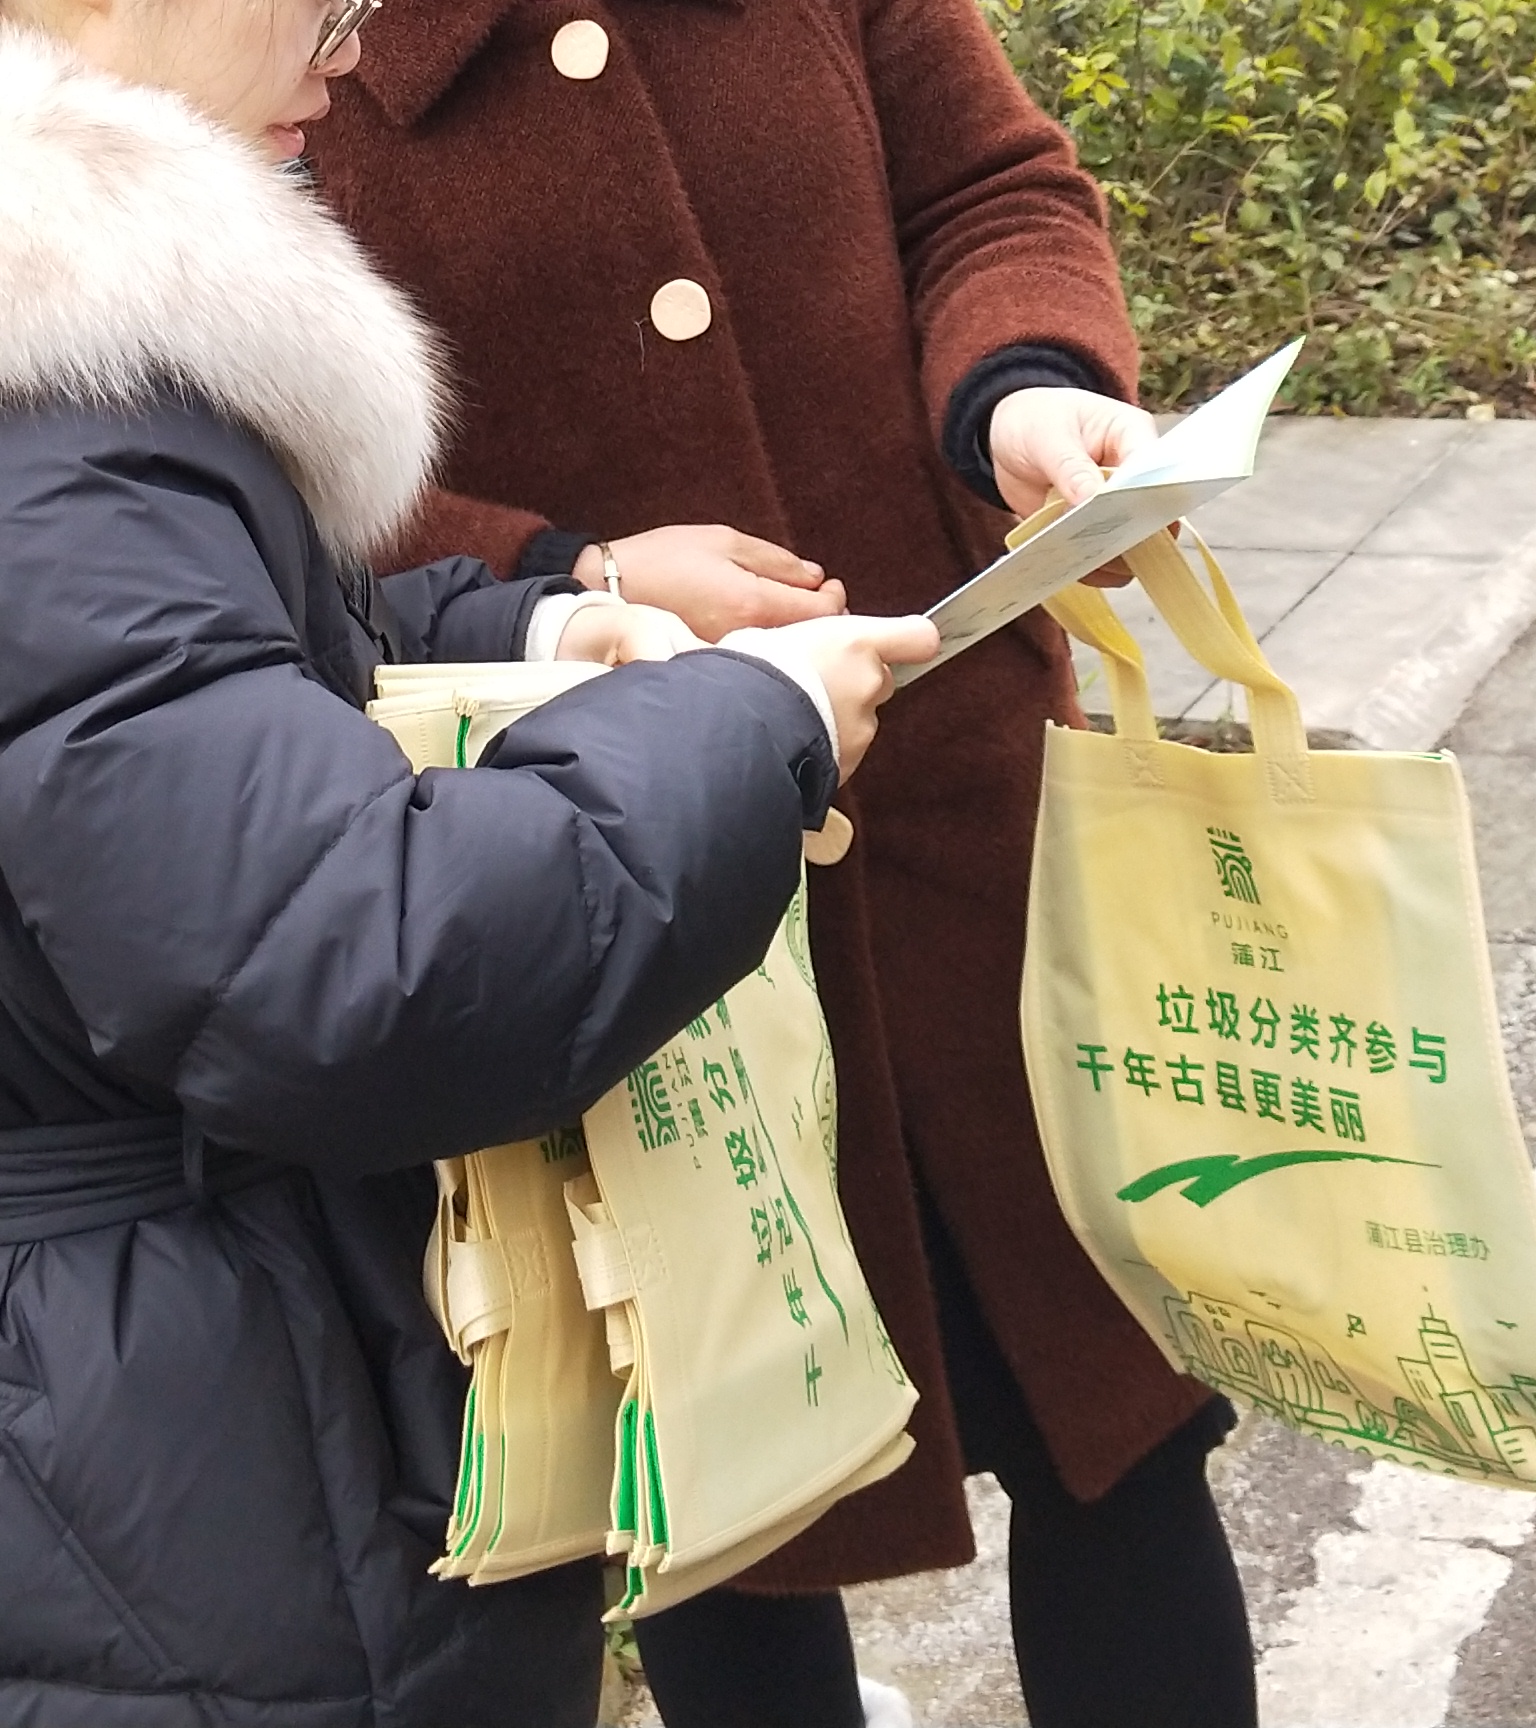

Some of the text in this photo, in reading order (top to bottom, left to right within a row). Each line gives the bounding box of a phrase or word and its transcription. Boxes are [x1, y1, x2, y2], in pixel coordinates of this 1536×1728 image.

[1210, 911, 1289, 940] PUJIANG
[1231, 942, 1285, 972] 蒲江
[1156, 982, 1448, 1084] 垃圾分类齐参与
